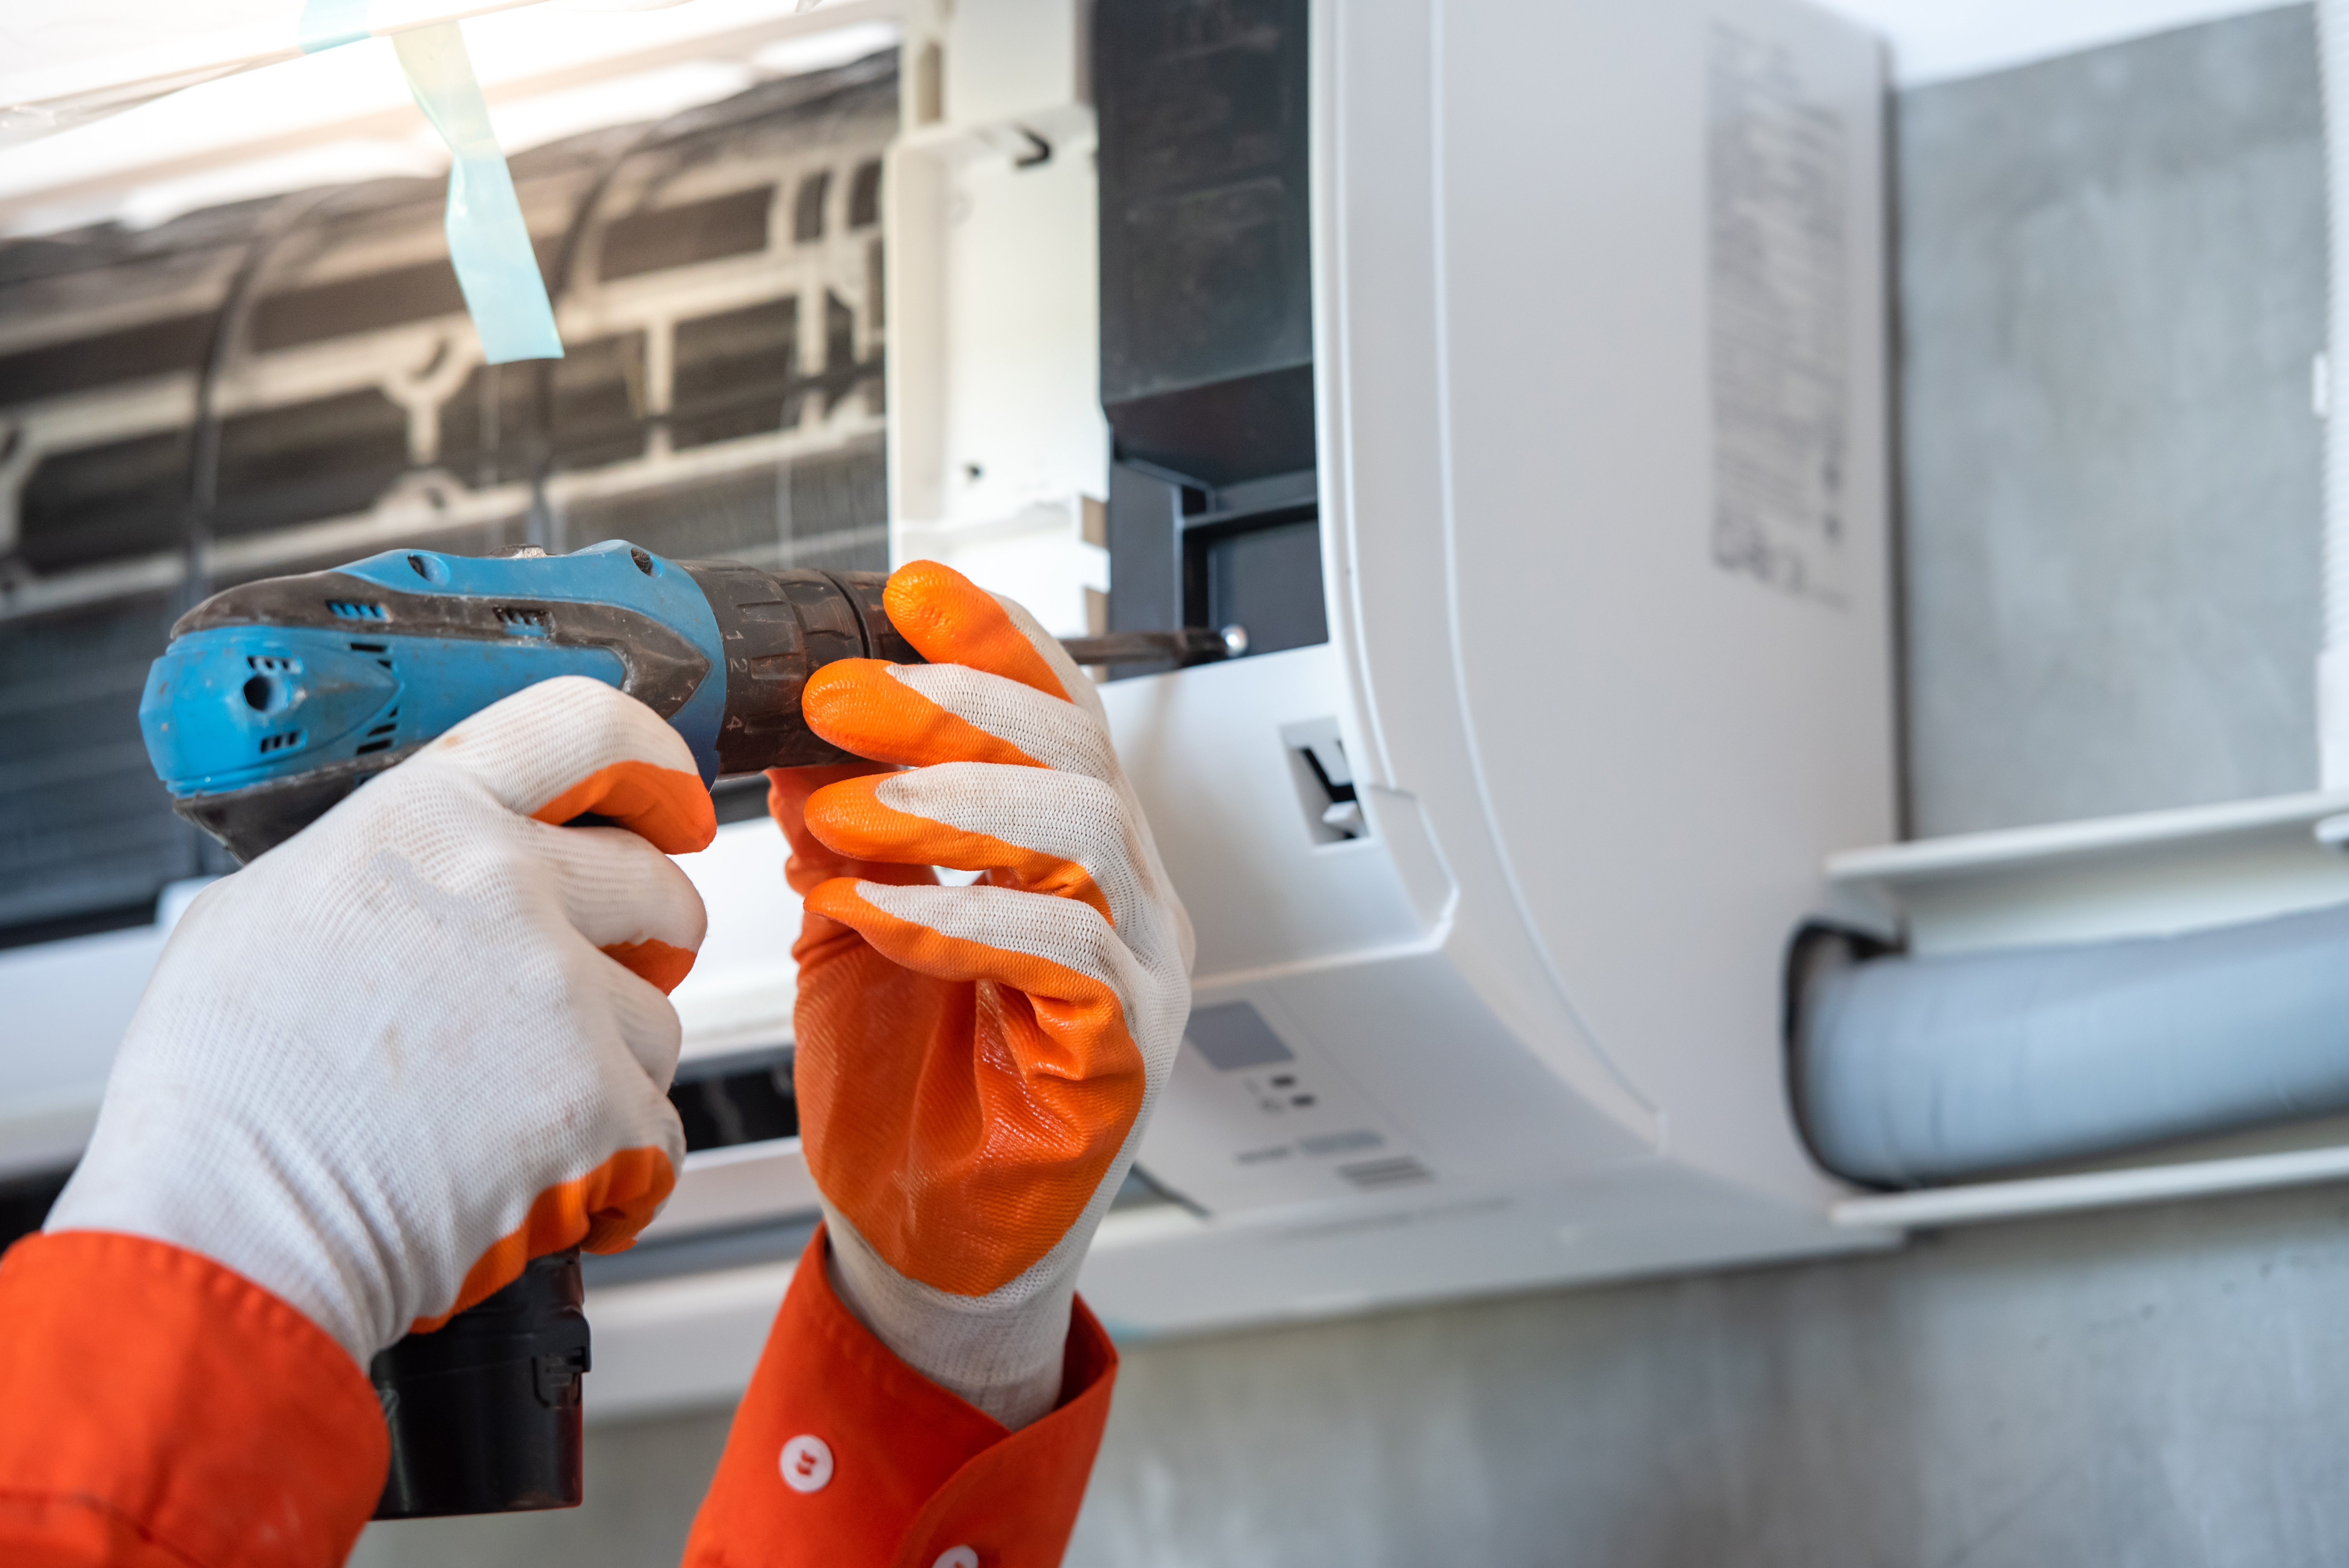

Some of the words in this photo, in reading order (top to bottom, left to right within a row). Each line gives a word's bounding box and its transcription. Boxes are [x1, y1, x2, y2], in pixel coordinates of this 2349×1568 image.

[726, 630, 744, 640] 1
[729, 658, 747, 673] 2
[726, 715, 743, 731] 4
